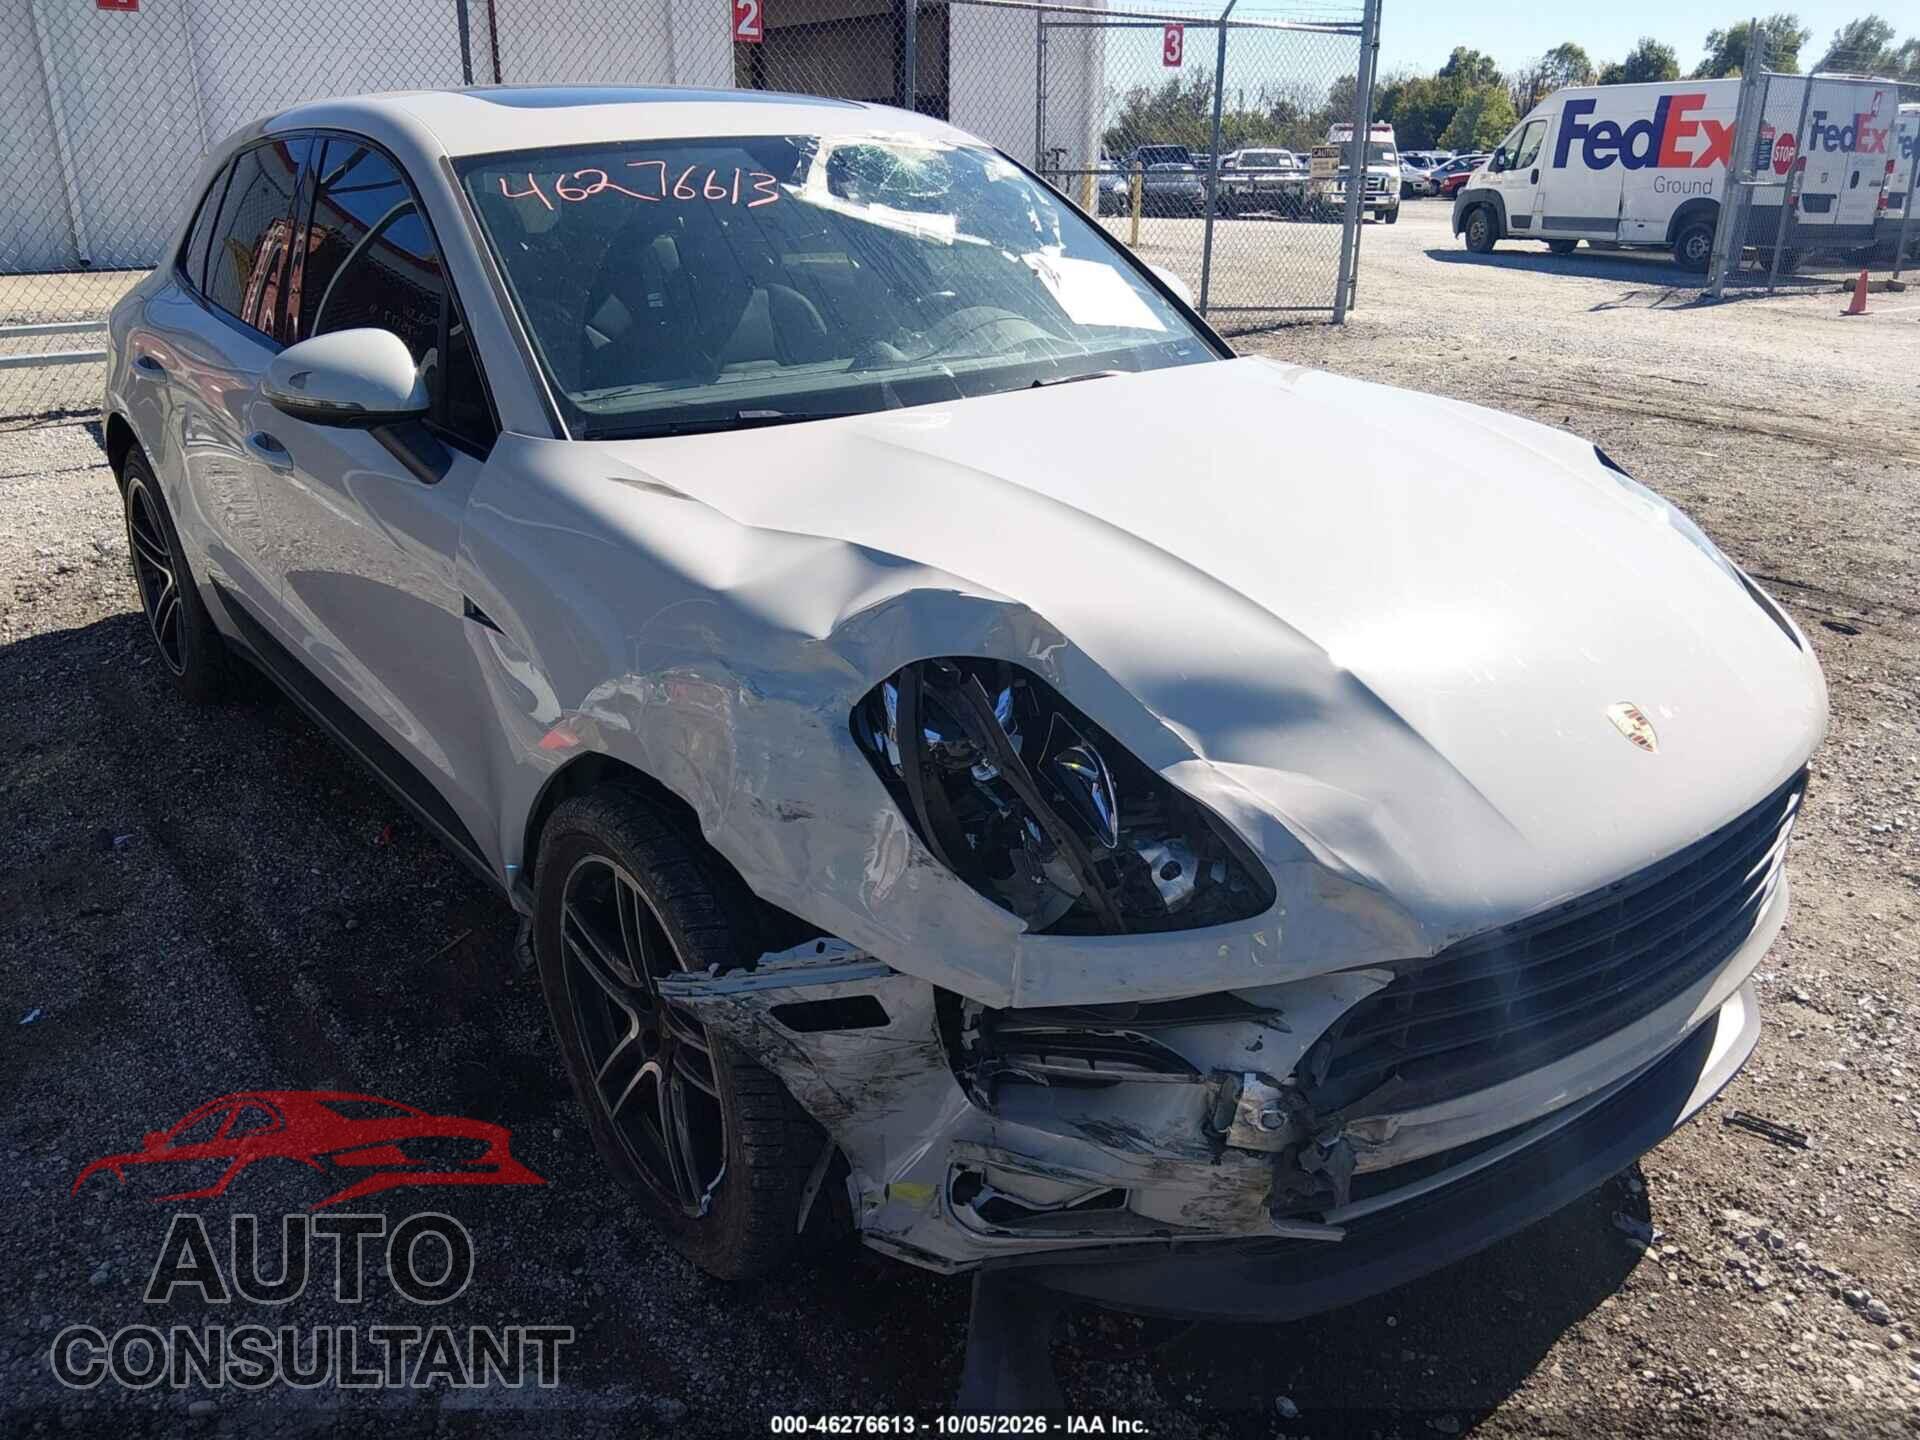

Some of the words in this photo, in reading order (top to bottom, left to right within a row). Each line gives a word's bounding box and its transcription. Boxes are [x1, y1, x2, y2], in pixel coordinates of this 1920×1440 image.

[737, 0, 759, 36] 2
[1166, 30, 1181, 62] 3
[1552, 94, 1737, 170] FedEx
[1809, 110, 1889, 154] FedEx
[1774, 146, 1795, 162] STOP
[1653, 175, 1713, 195] Ground
